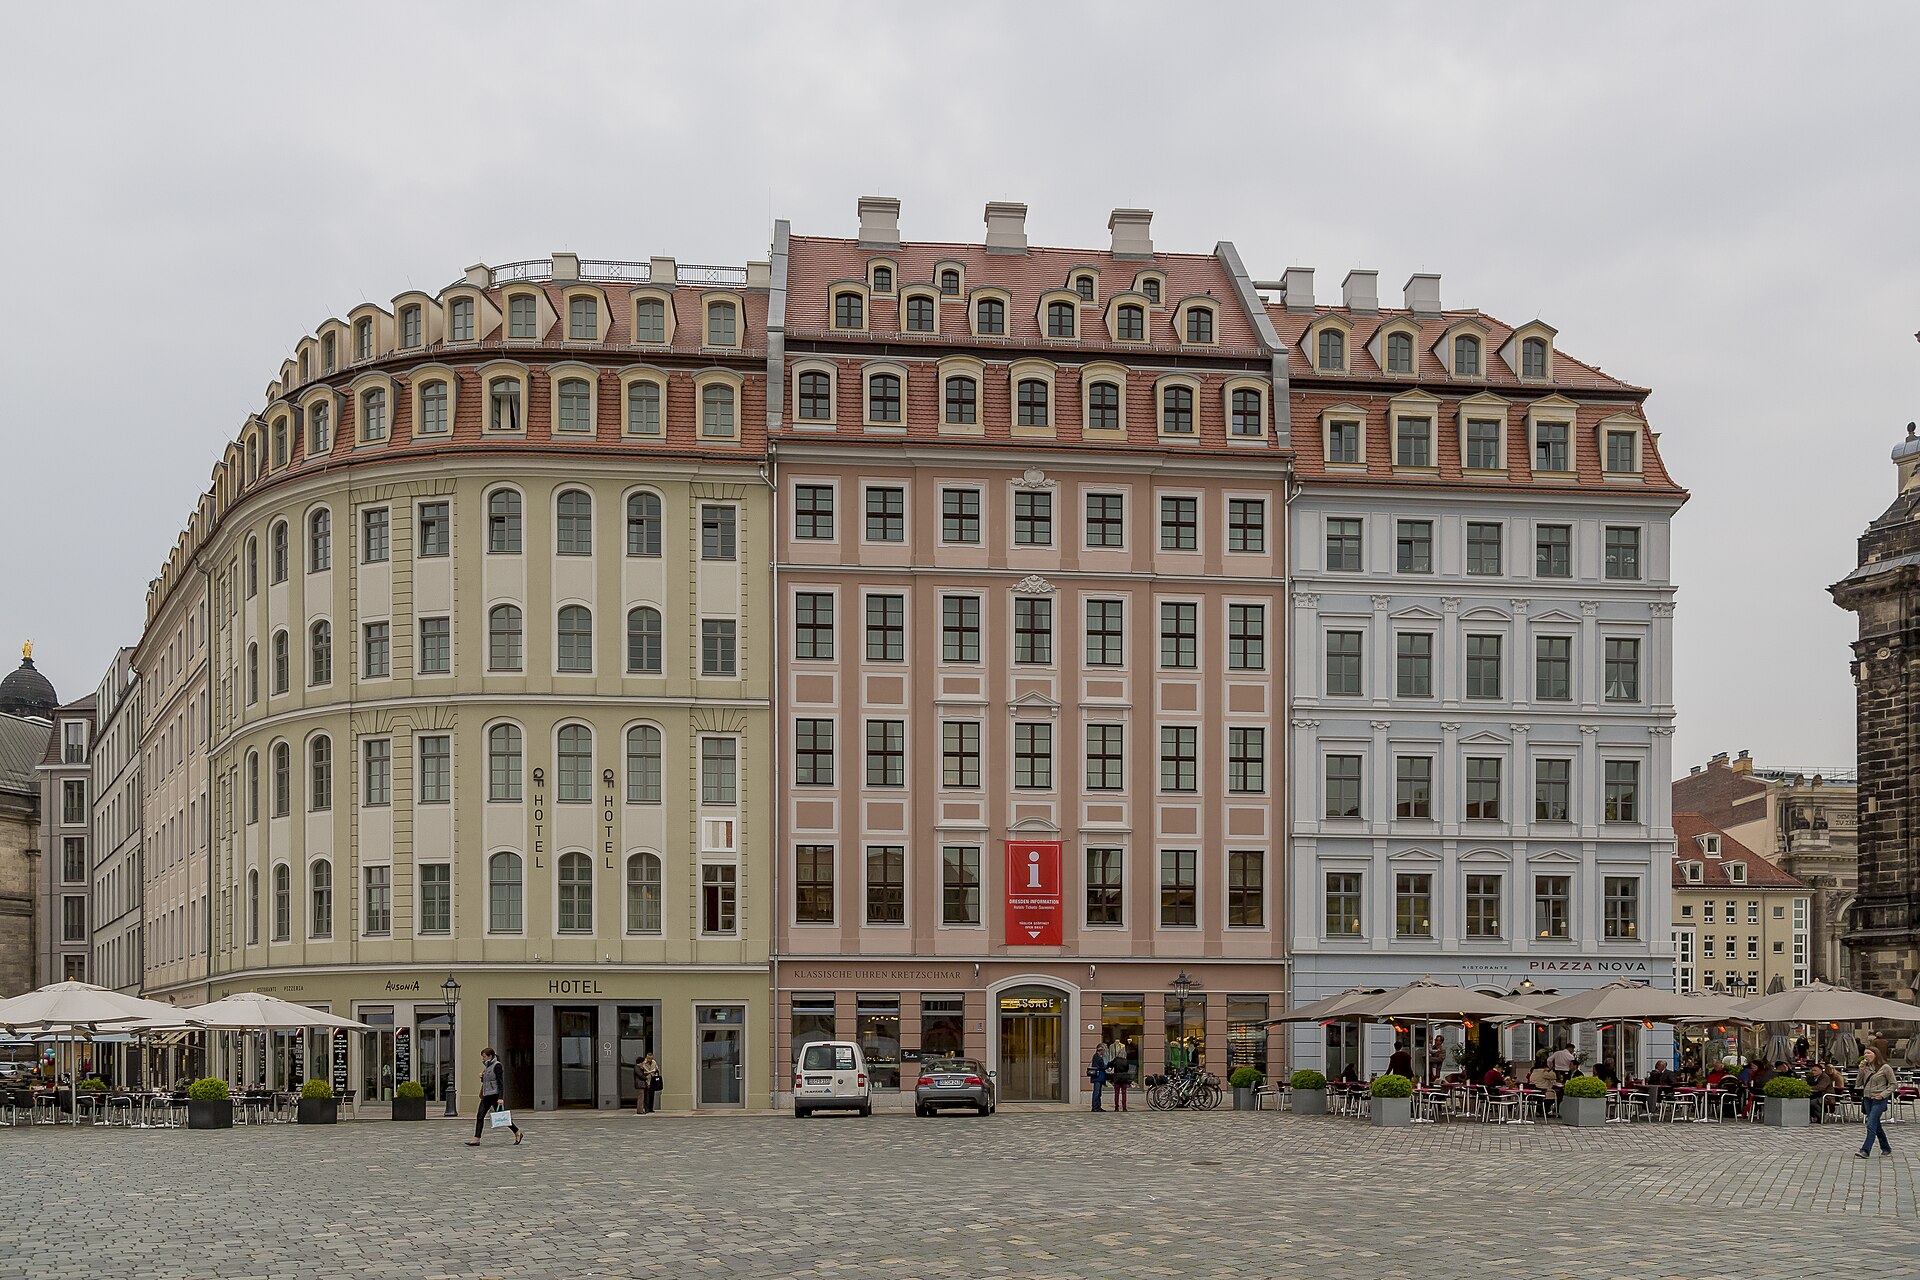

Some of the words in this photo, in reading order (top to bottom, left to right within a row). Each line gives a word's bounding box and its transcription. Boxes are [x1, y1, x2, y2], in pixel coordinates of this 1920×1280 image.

[534, 794, 544, 868] HOTEL
[604, 795, 614, 869] HOTEL
[1529, 961, 1593, 970] PIAZZA
[1598, 962, 1646, 971] NOVA
[794, 970, 852, 978] KLASSISCHE
[855, 971, 888, 979] UHREN
[891, 971, 961, 979] KRETZSCHMAR
[549, 980, 602, 993] HOTEL
